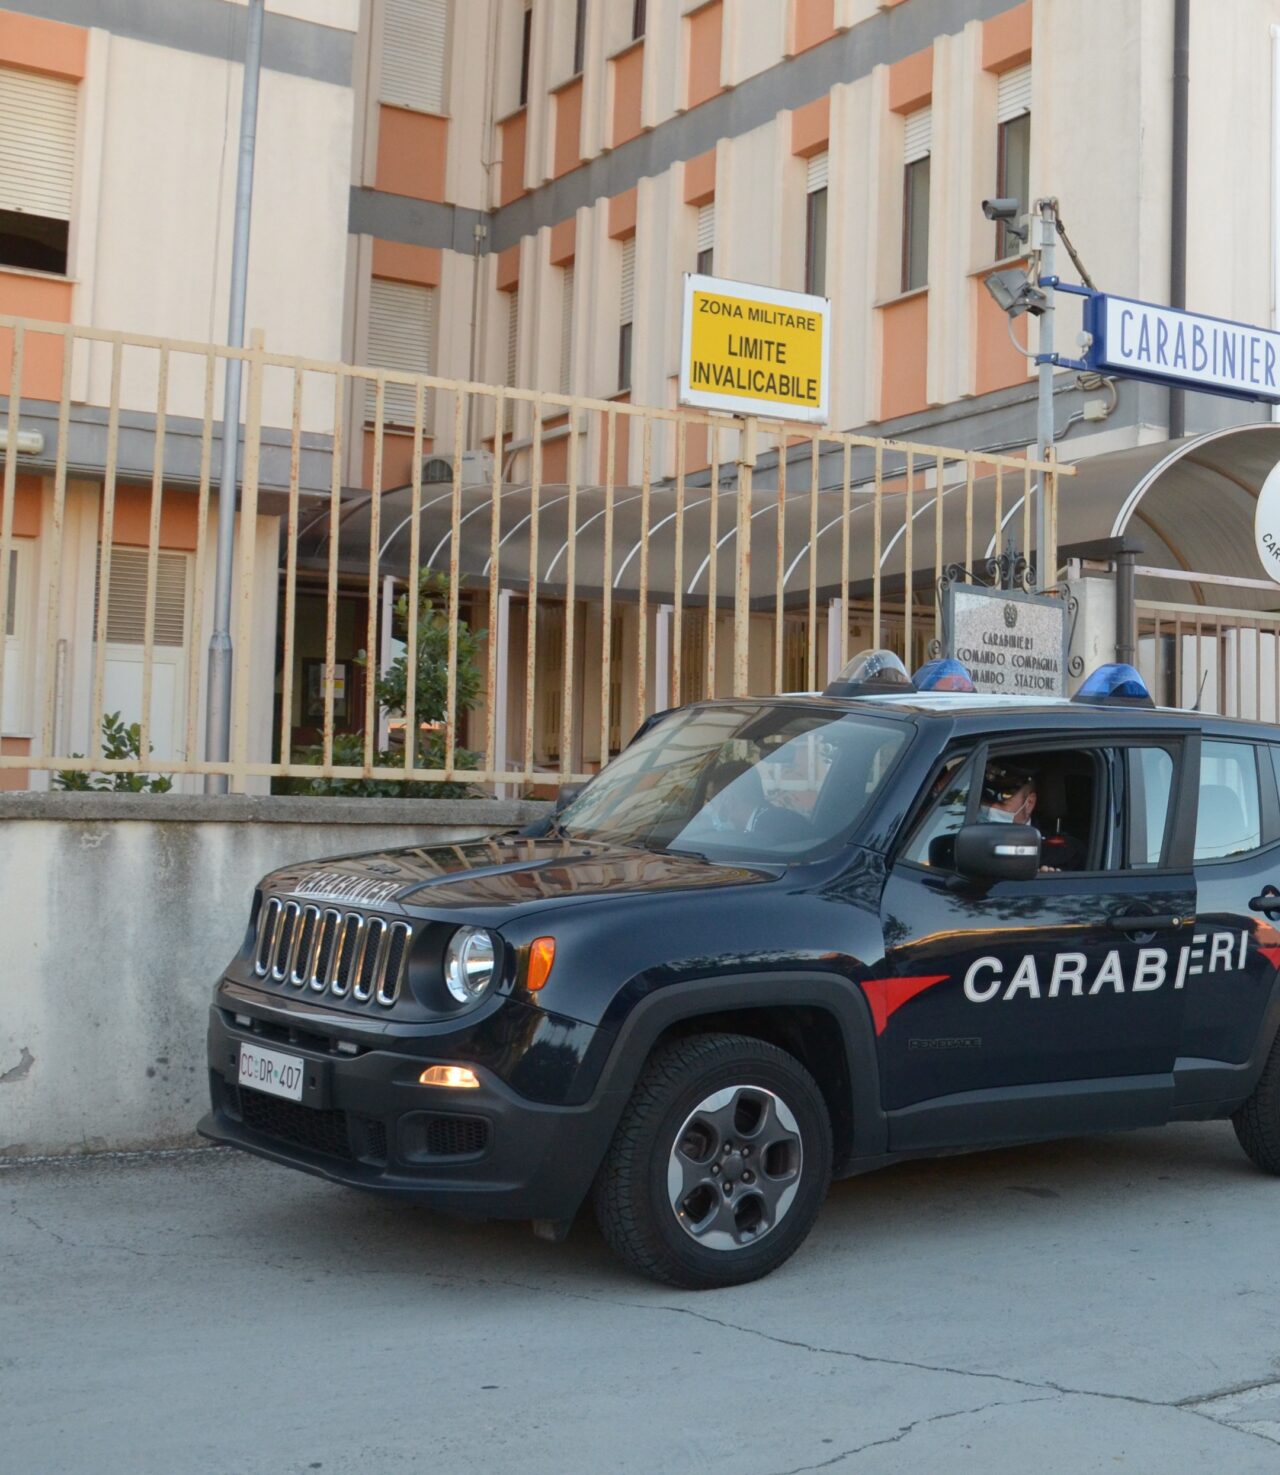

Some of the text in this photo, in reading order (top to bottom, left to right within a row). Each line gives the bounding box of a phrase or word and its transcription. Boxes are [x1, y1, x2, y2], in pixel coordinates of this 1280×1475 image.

[700, 299, 816, 332] ZONA MILITARE
[728, 334, 787, 364] LIMITE
[692, 360, 817, 401] INVALICABILE
[982, 631, 1034, 651] CARABINIERI
[956, 647, 1058, 673] COMANDO COMPAGNIA
[1014, 673, 1056, 691] STAZIONE
[294, 871, 407, 908] CARABINIERI
